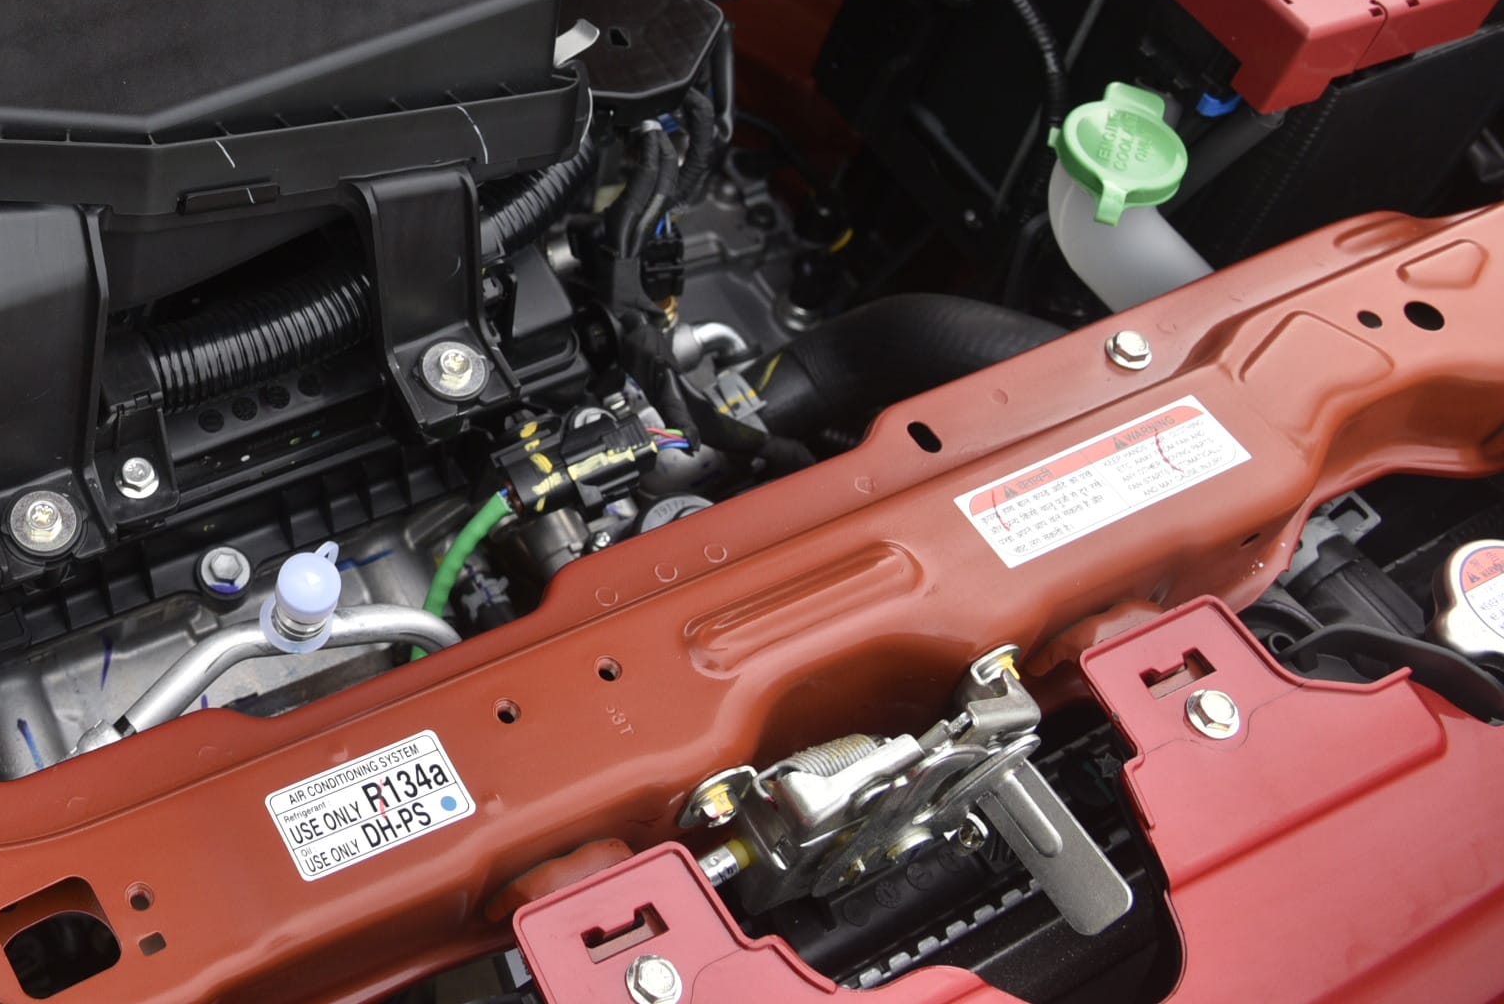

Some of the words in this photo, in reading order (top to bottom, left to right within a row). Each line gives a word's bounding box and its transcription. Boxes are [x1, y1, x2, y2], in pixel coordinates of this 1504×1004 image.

[1123, 415, 1175, 441] WARNING
[288, 789, 306, 806] AIR
[307, 760, 379, 797] CONDITIONING
[379, 744, 420, 771] SYSTEM
[289, 819, 324, 846] USE
[322, 801, 364, 832] ONLY
[361, 762, 450, 814] R134a
[283, 802, 328, 824] Refrigerant
[305, 849, 333, 874] USE
[330, 838, 362, 863] ONLY
[361, 802, 432, 848] DH-PS
